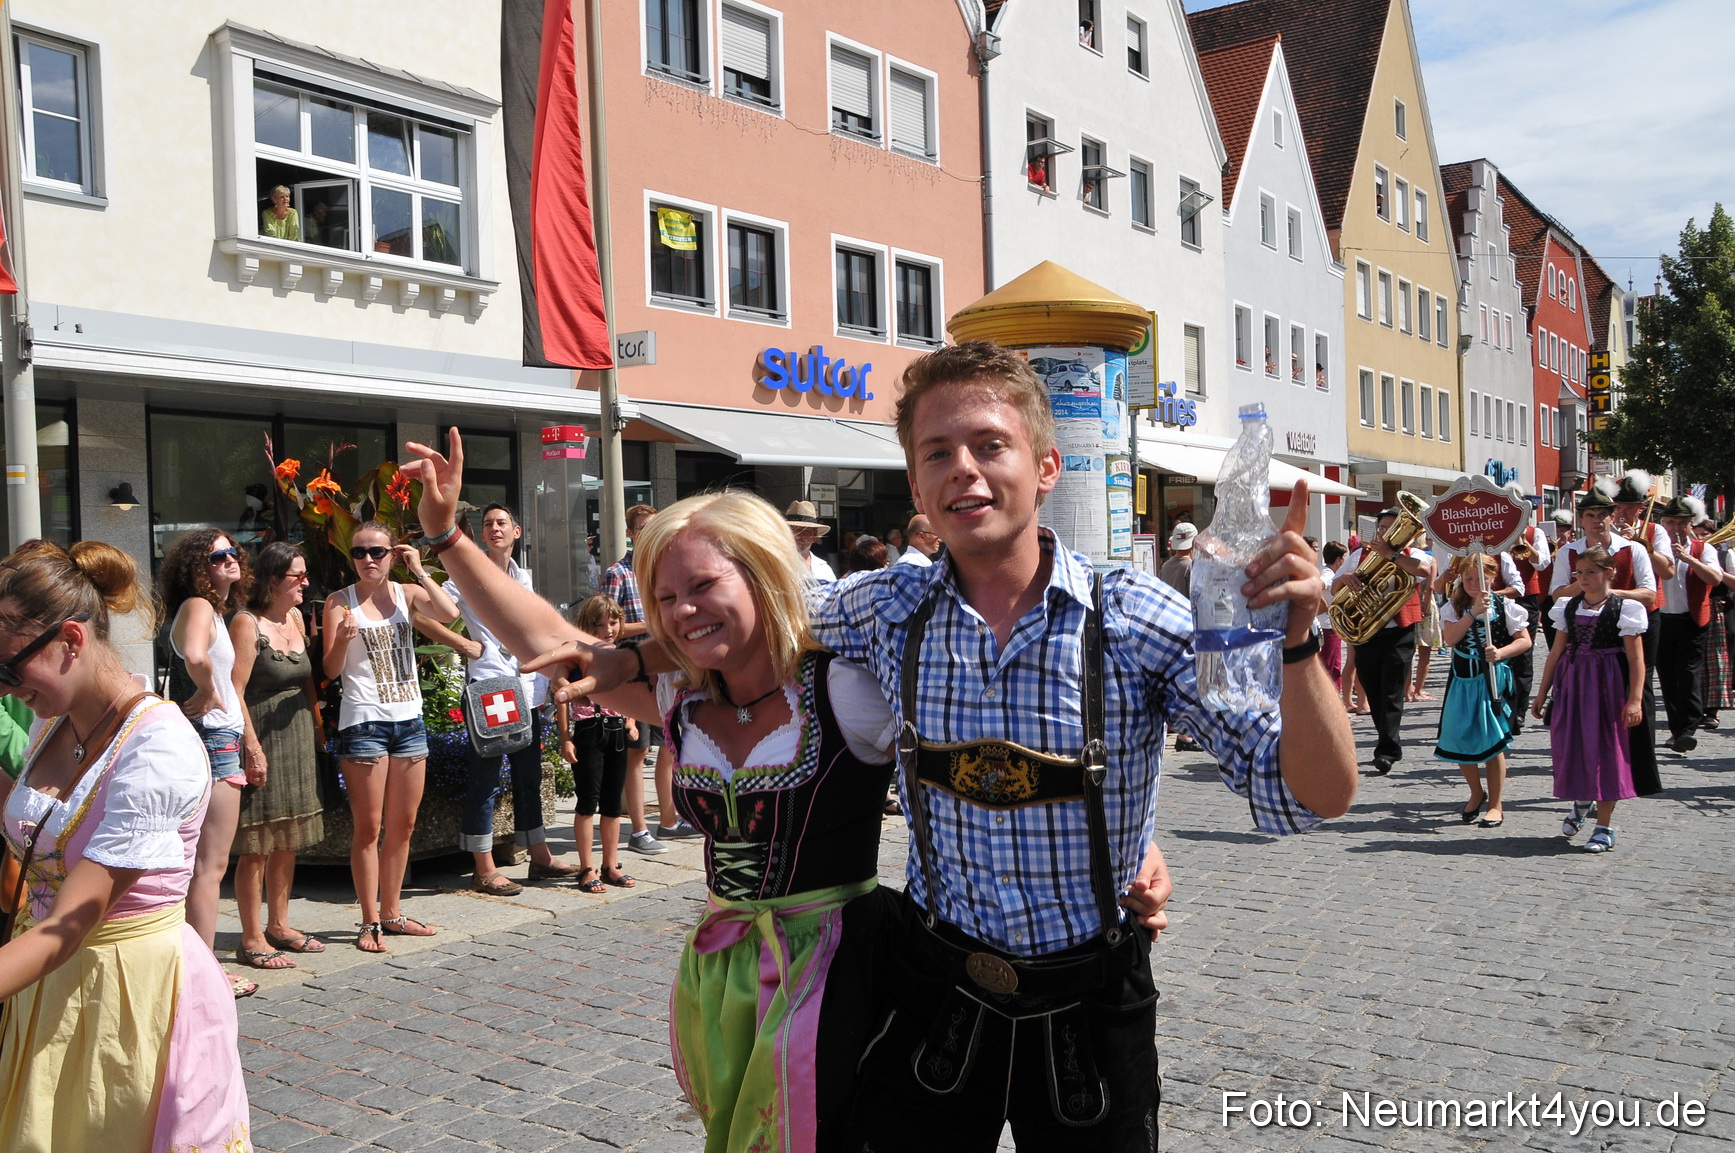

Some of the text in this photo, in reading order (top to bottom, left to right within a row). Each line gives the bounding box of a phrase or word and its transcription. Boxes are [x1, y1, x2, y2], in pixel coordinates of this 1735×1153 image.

[759, 345, 874, 400] sutor.
[1441, 502, 1509, 521] Blaskapelle
[1448, 519, 1505, 535] Dirnhofer
